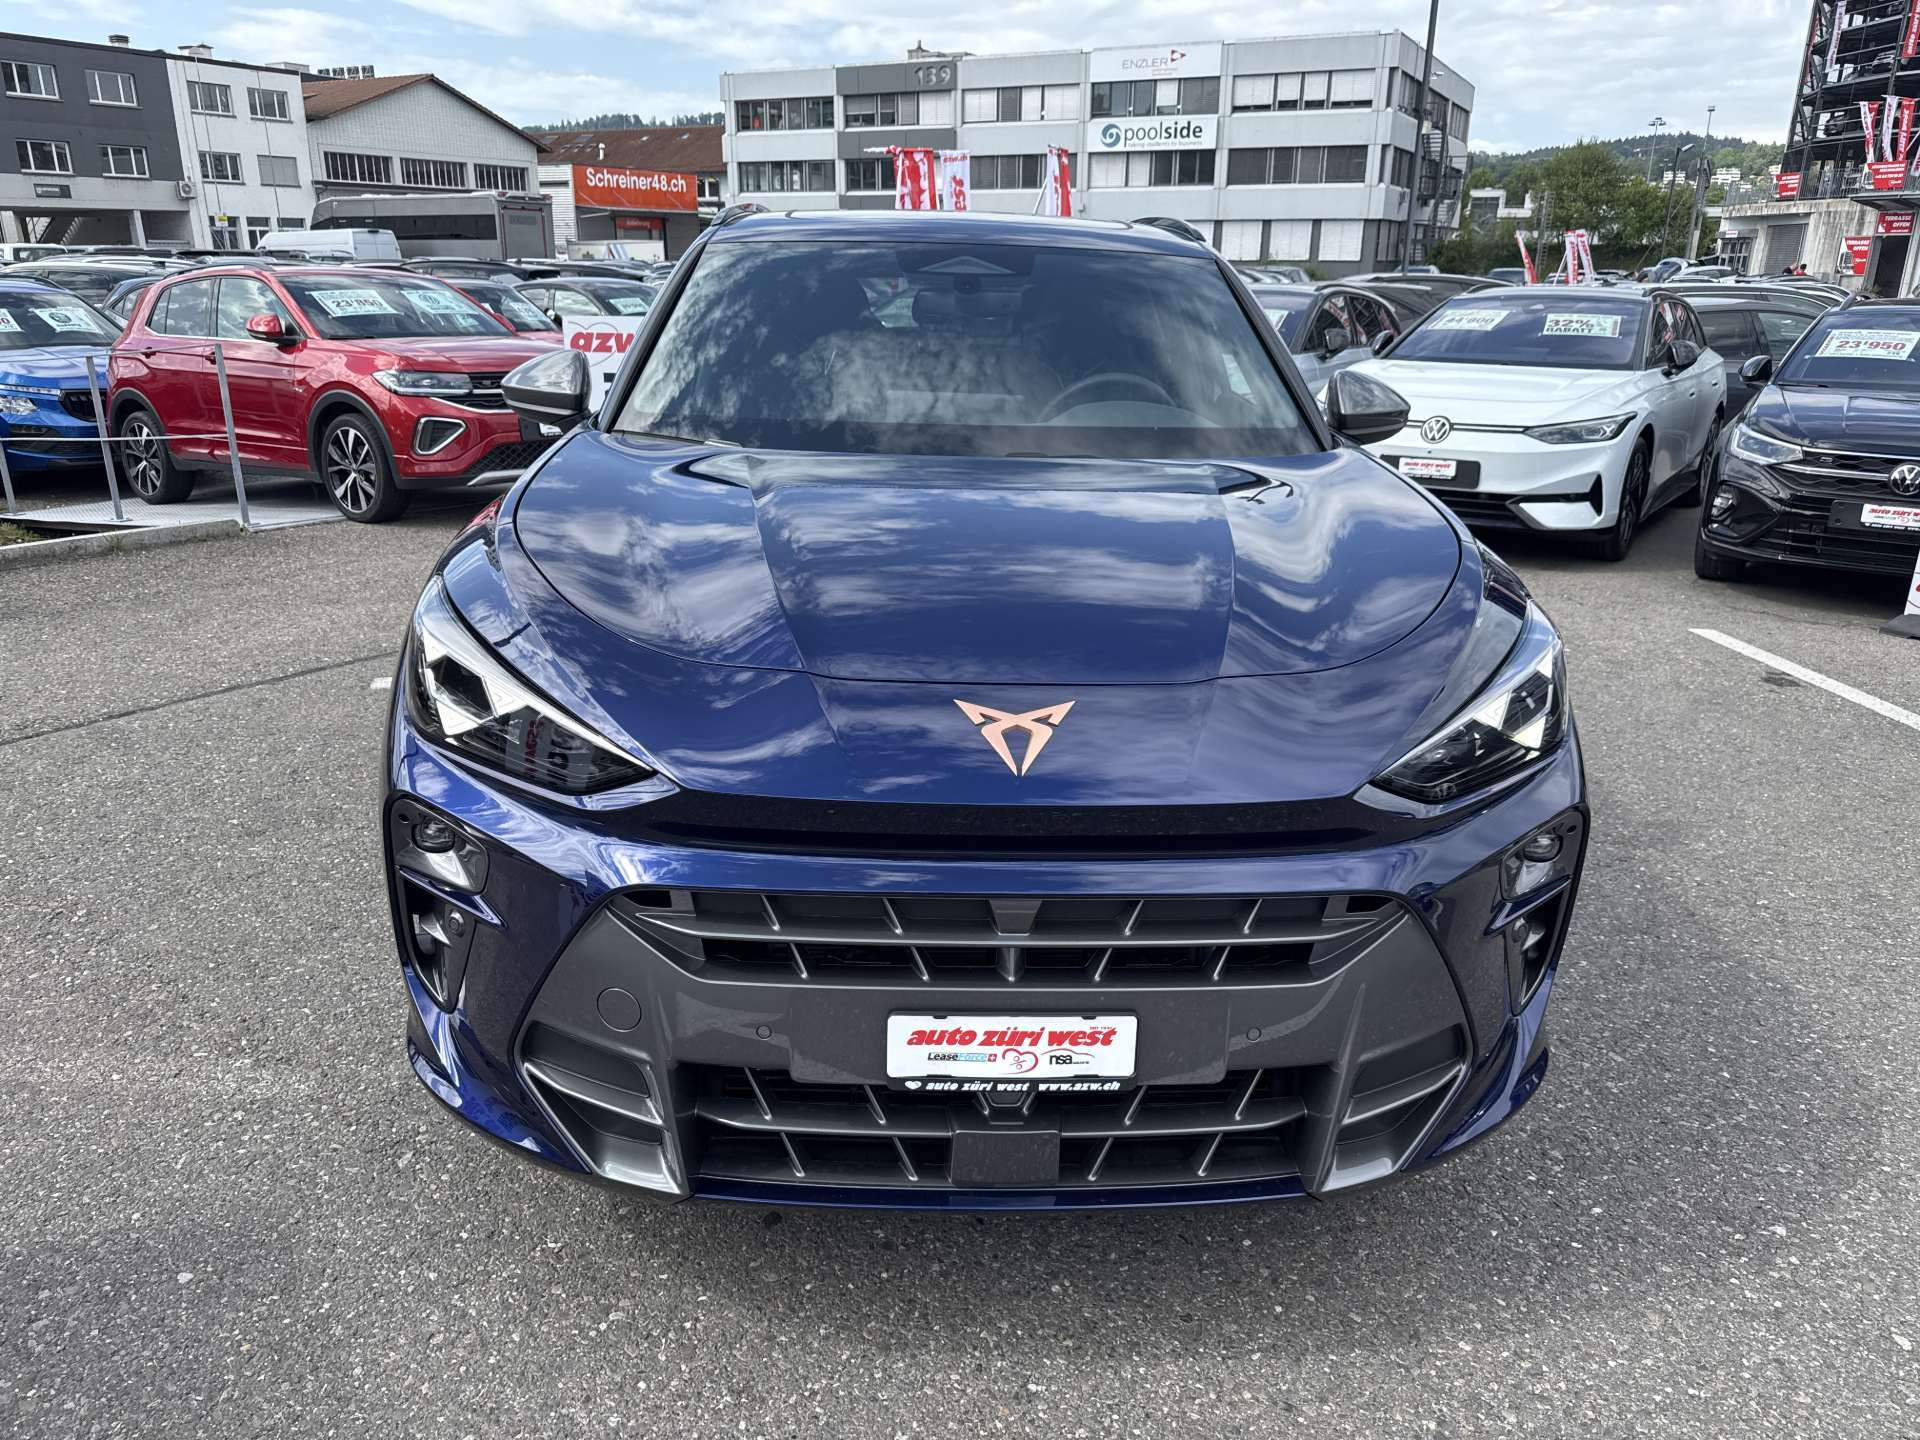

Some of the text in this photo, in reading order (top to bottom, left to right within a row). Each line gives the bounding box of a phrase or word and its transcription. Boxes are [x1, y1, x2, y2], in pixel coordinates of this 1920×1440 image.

[1122, 57, 1168, 70] ENZLER
[914, 65, 951, 87] 139
[1124, 120, 1203, 148] poolside
[586, 167, 687, 193] Schreiner48.ch
[1548, 319, 1594, 328] 32%
[1836, 340, 1907, 351] 23'950
[906, 1026, 1118, 1047] auto züri west
[1049, 1054, 1073, 1065] nsa
[925, 1080, 1121, 1091] auto züri west www.azw.ch
